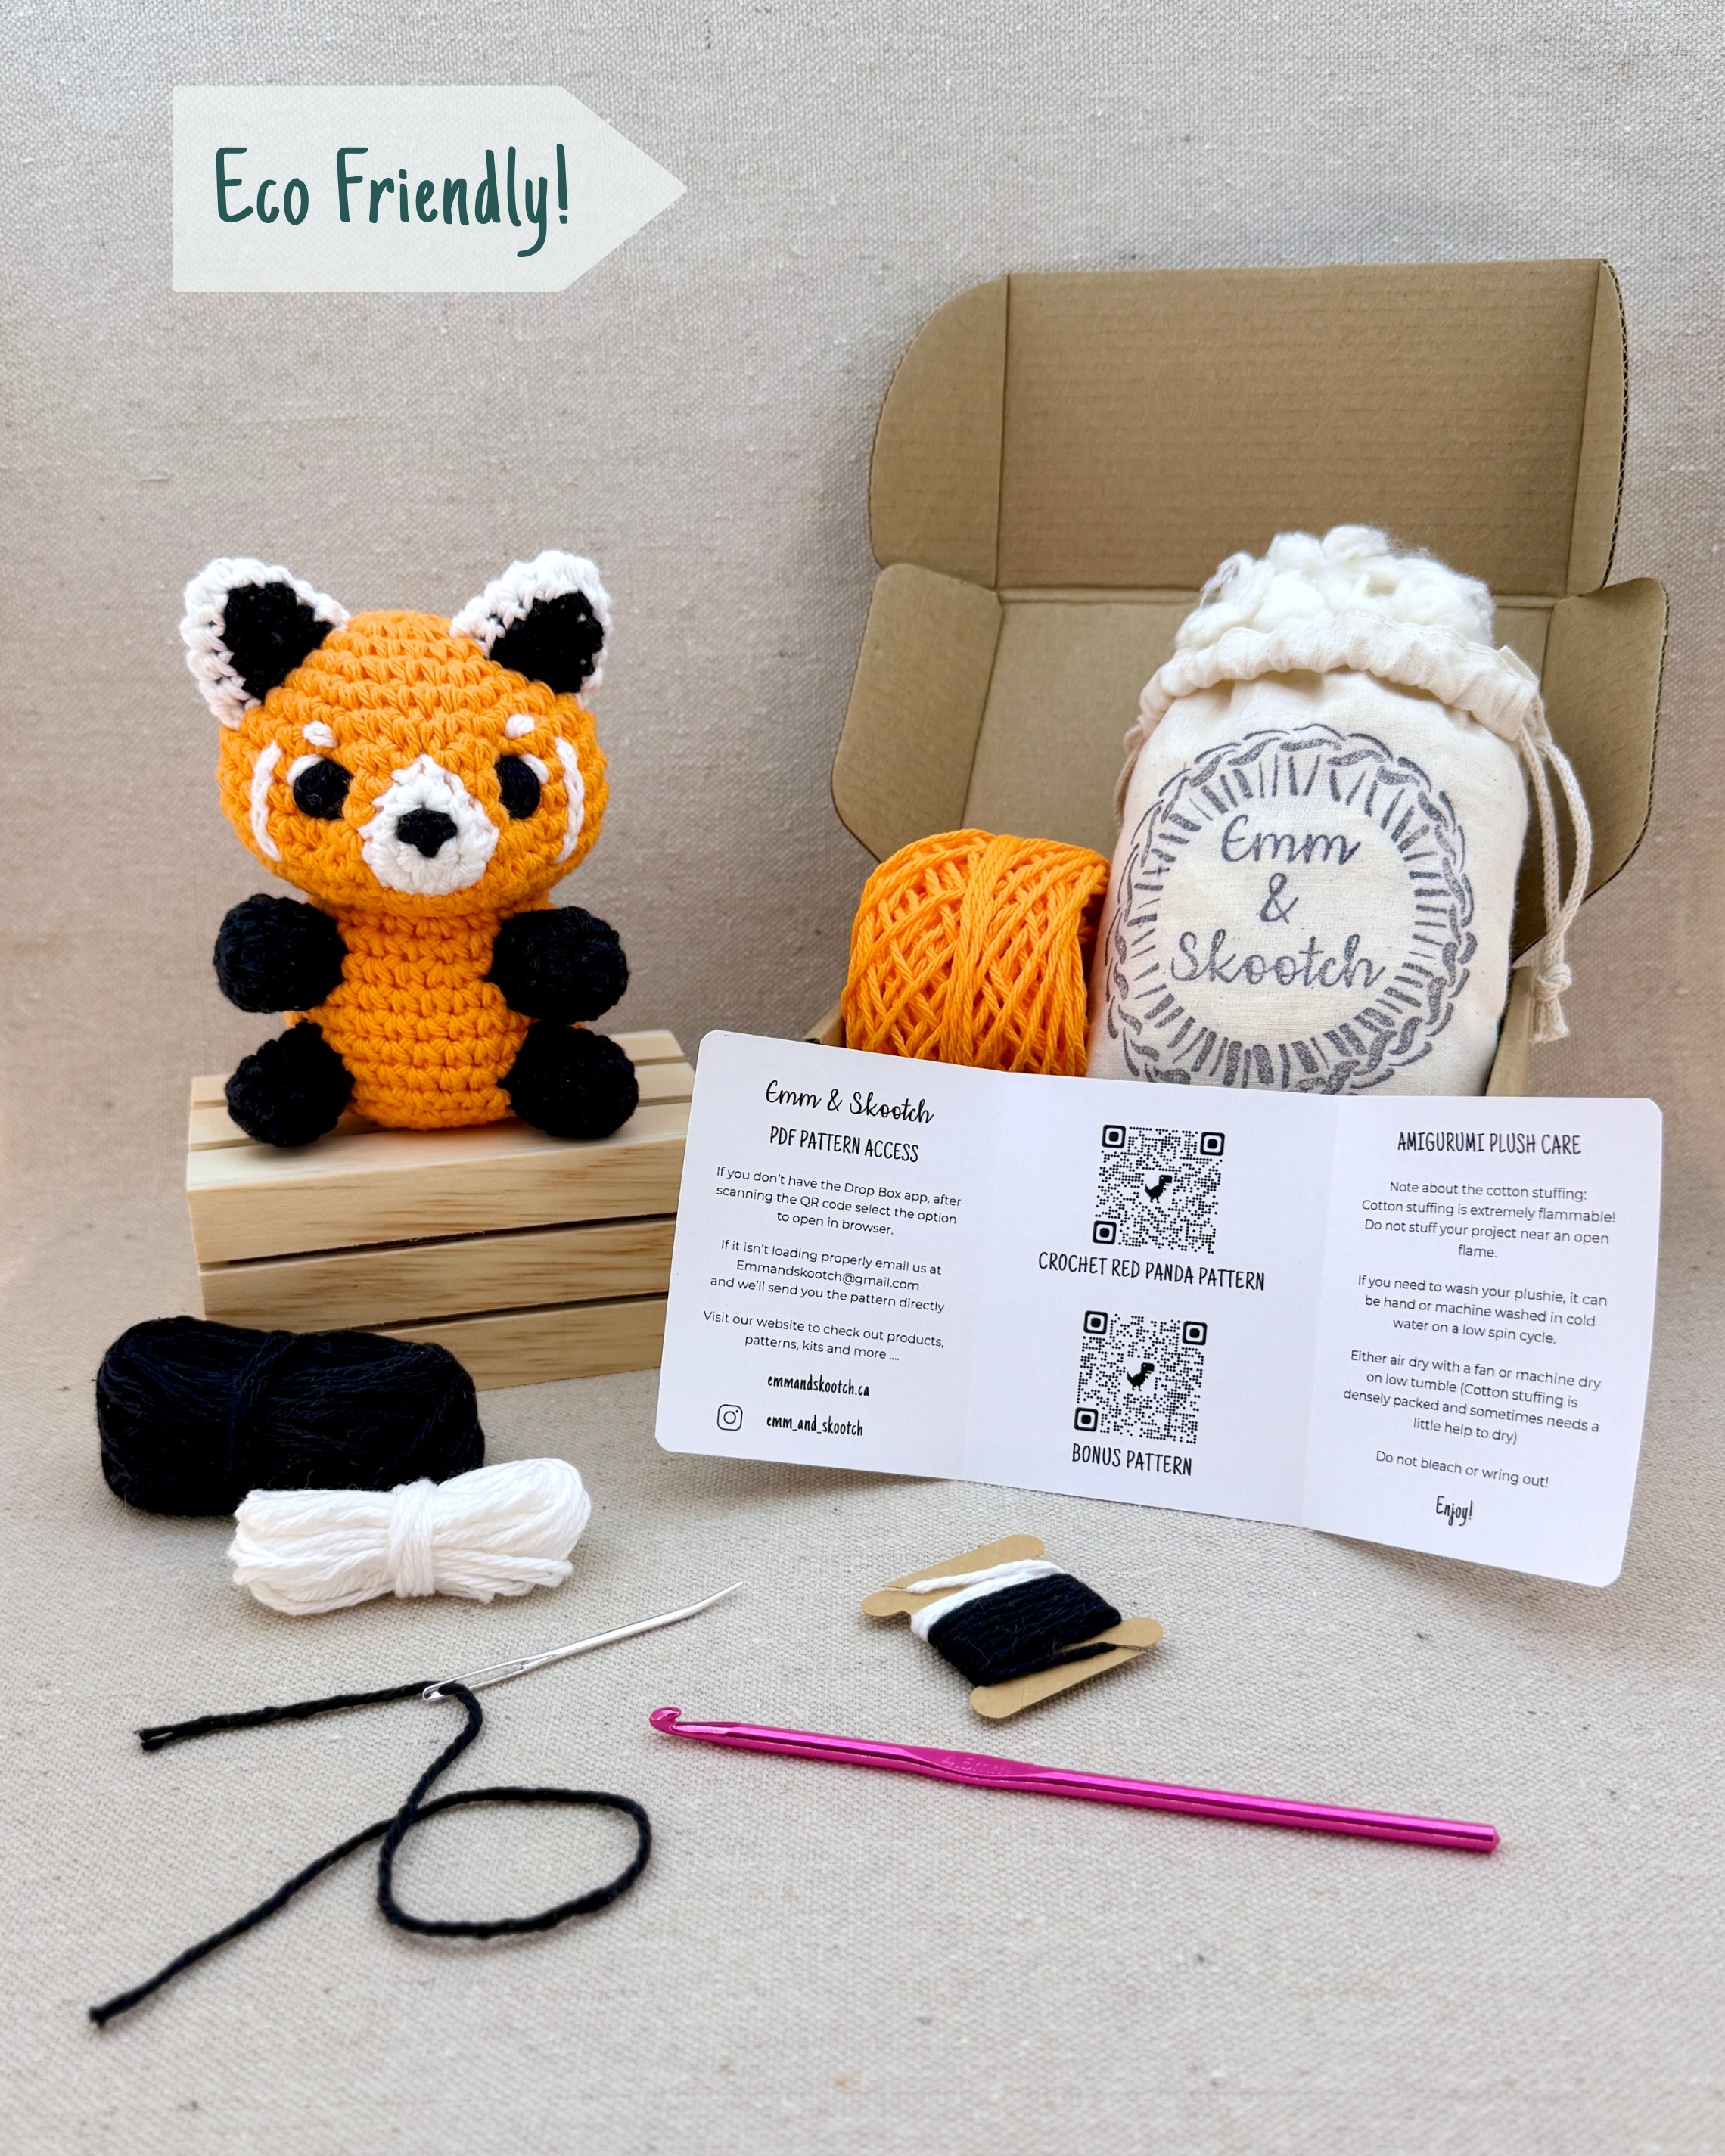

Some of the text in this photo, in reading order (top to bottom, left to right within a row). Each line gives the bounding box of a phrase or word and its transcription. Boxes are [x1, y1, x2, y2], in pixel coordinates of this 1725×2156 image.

[1220, 814, 1361, 865] Emm
[1257, 872, 1299, 924] &
[1170, 929, 1387, 988] Skootch
[766, 1080, 934, 1123] Emm & Skootch
[770, 1126, 919, 1163] PDF PATTERN ACCESS
[1397, 1132, 1581, 1155] AMIGURUMI PLUSH CARE
[717, 1167, 962, 1207] If you don't have the Drop Box app, after
[1390, 1182, 1587, 1203] Note about the cotton stuffing:
[716, 1187, 956, 1224] scanning the QR code select the option
[1362, 1200, 1615, 1222] Cotton stuffing is extremely flammable!
[777, 1212, 894, 1235] to open in browser.
[1365, 1219, 1608, 1245] Do not stuff your project near an open
[722, 1239, 941, 1275] If it isn't loading properly email us at
[1459, 1244, 1497, 1258] flame.
[737, 1260, 919, 1291] Emmandskootch@gmail.com
[1039, 1251, 1265, 1291] CROCHET RED PANDA PATTERN
[710, 1278, 945, 1314] and we'll send you the pattern directly
[1357, 1274, 1607, 1306] If you need to wash your plushie, it can
[1366, 1294, 1596, 1327] be hand or machine washed in cold
[704, 1309, 943, 1349] Visit our website to check out products,
[1393, 1319, 1556, 1344] water on a low spin cycle.
[745, 1336, 799, 1351] patterns,
[803, 1340, 823, 1352] kits
[827, 1345, 850, 1355] and
[854, 1348, 886, 1359] more
[767, 1374, 869, 1396] emmandskootch.ca
[1351, 1350, 1602, 1391] Either air dry with a fan or machine dry
[1366, 1373, 1578, 1409] on low tumble (Cotton stuffing is
[766, 1414, 863, 1436] emm_and_skootch
[1344, 1389, 1599, 1432] densely packed and sometimes needs a
[1413, 1417, 1517, 1445] little help to dry)
[1072, 1443, 1192, 1476] BONUS PATTERN
[1376, 1450, 1549, 1487] Do not bleach or wring out!
[1436, 1496, 1473, 1527] Enjoy!
